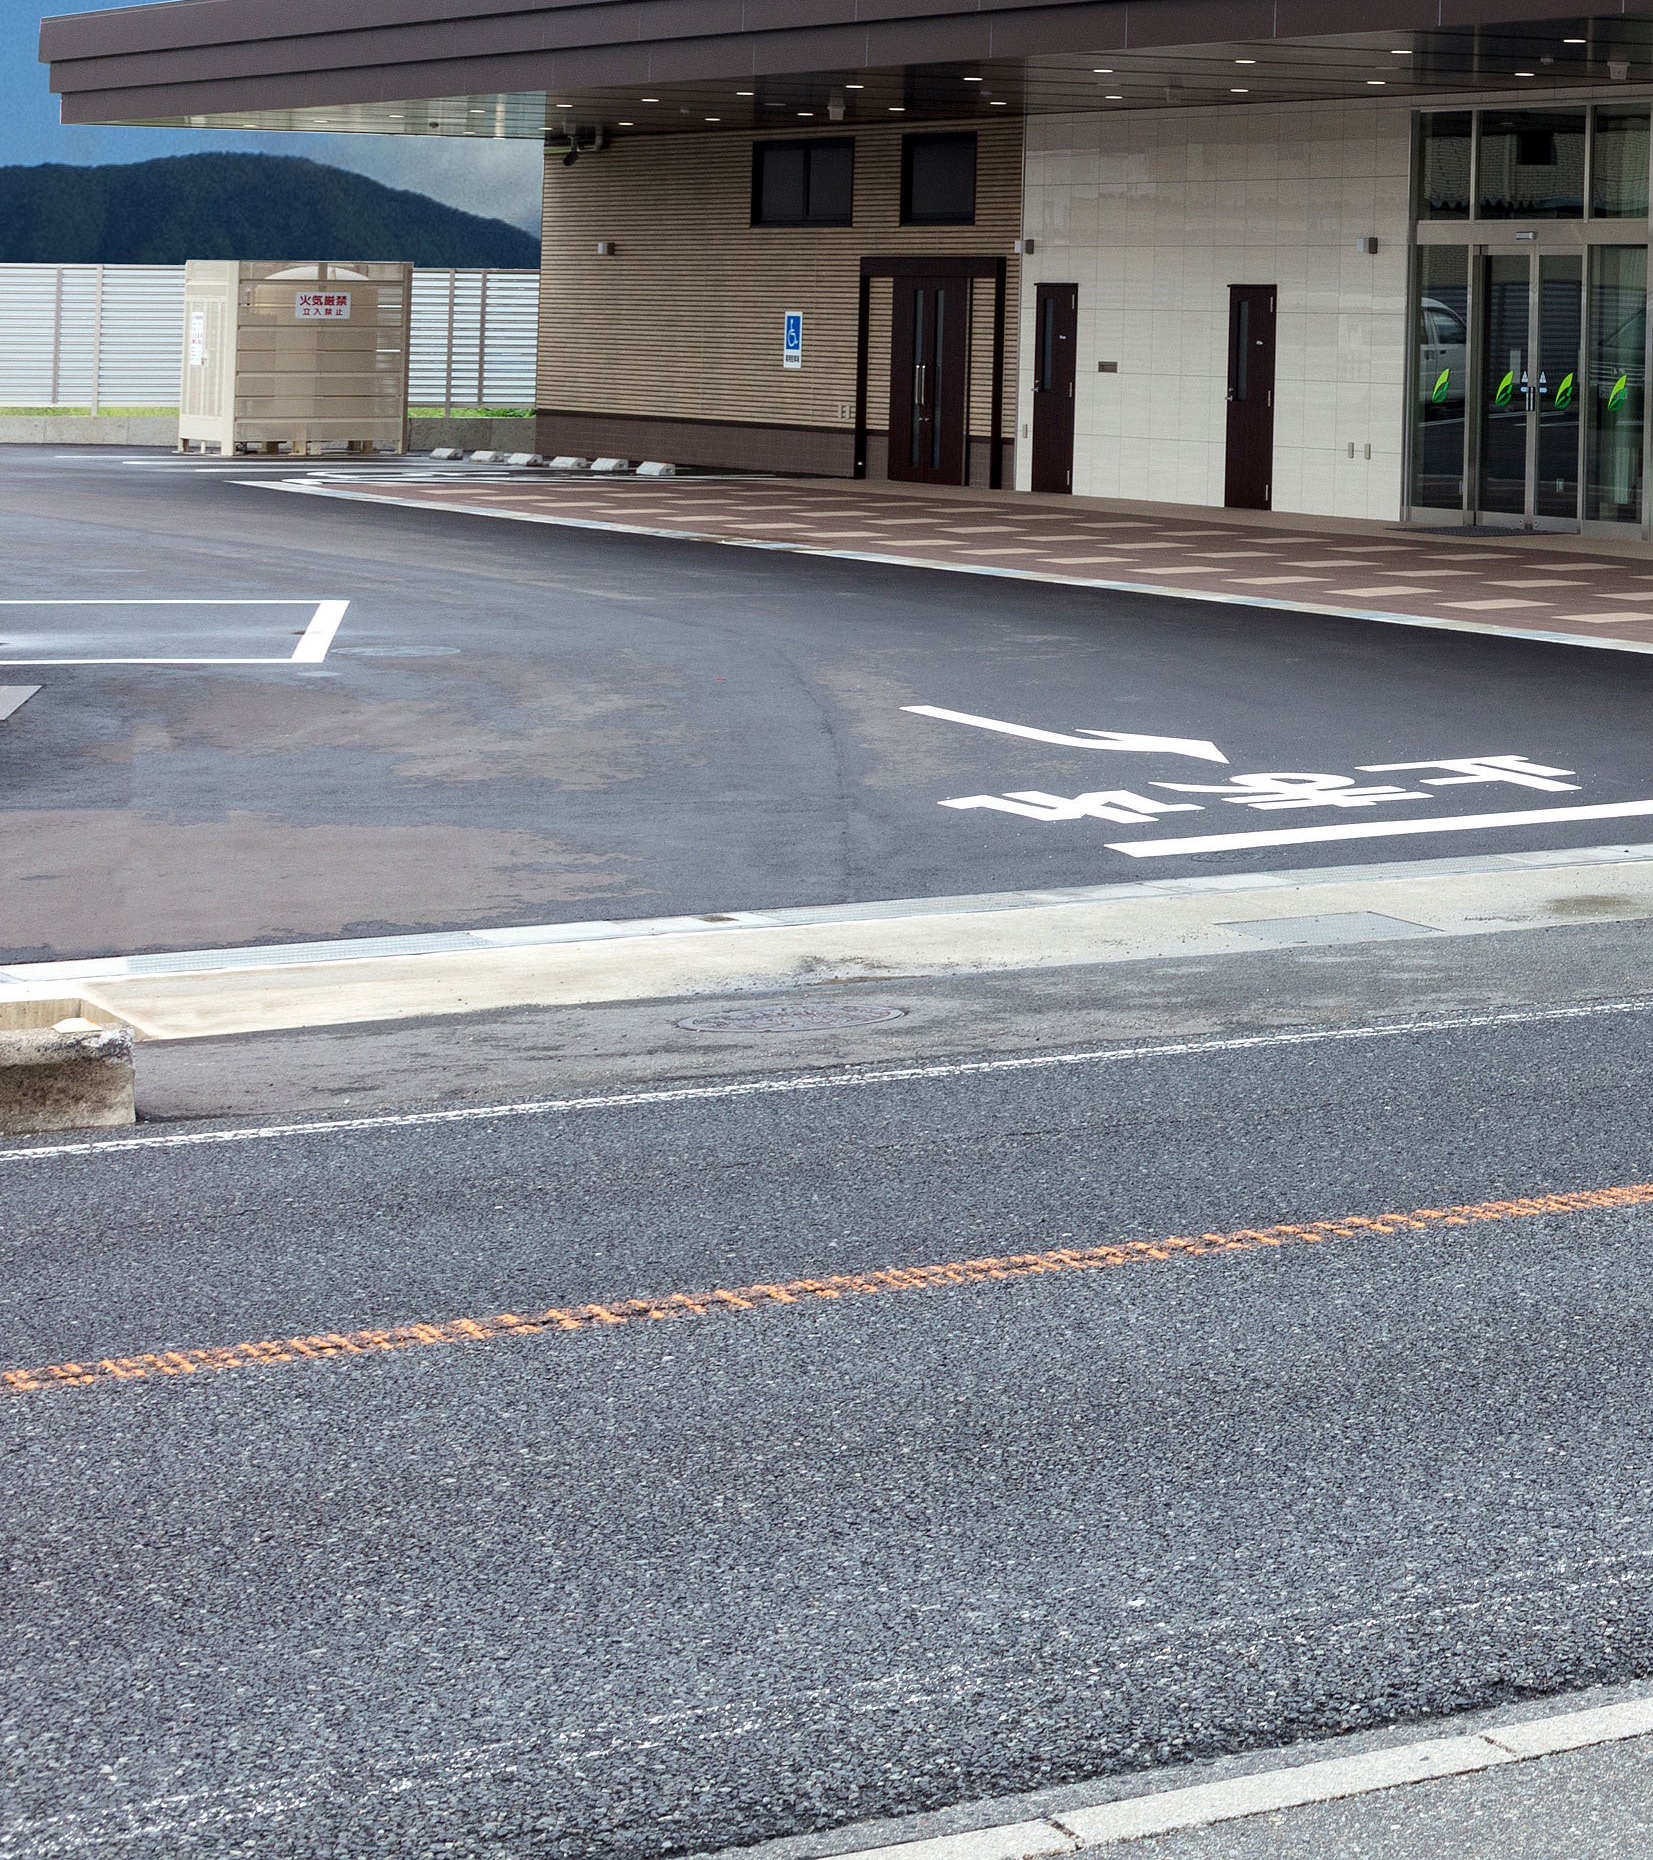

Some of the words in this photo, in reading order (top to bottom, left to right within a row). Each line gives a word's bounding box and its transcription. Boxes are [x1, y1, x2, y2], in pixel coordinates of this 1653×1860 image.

[299, 295, 347, 306] 火気厳禁
[302, 308, 343, 316] 立入禁止
